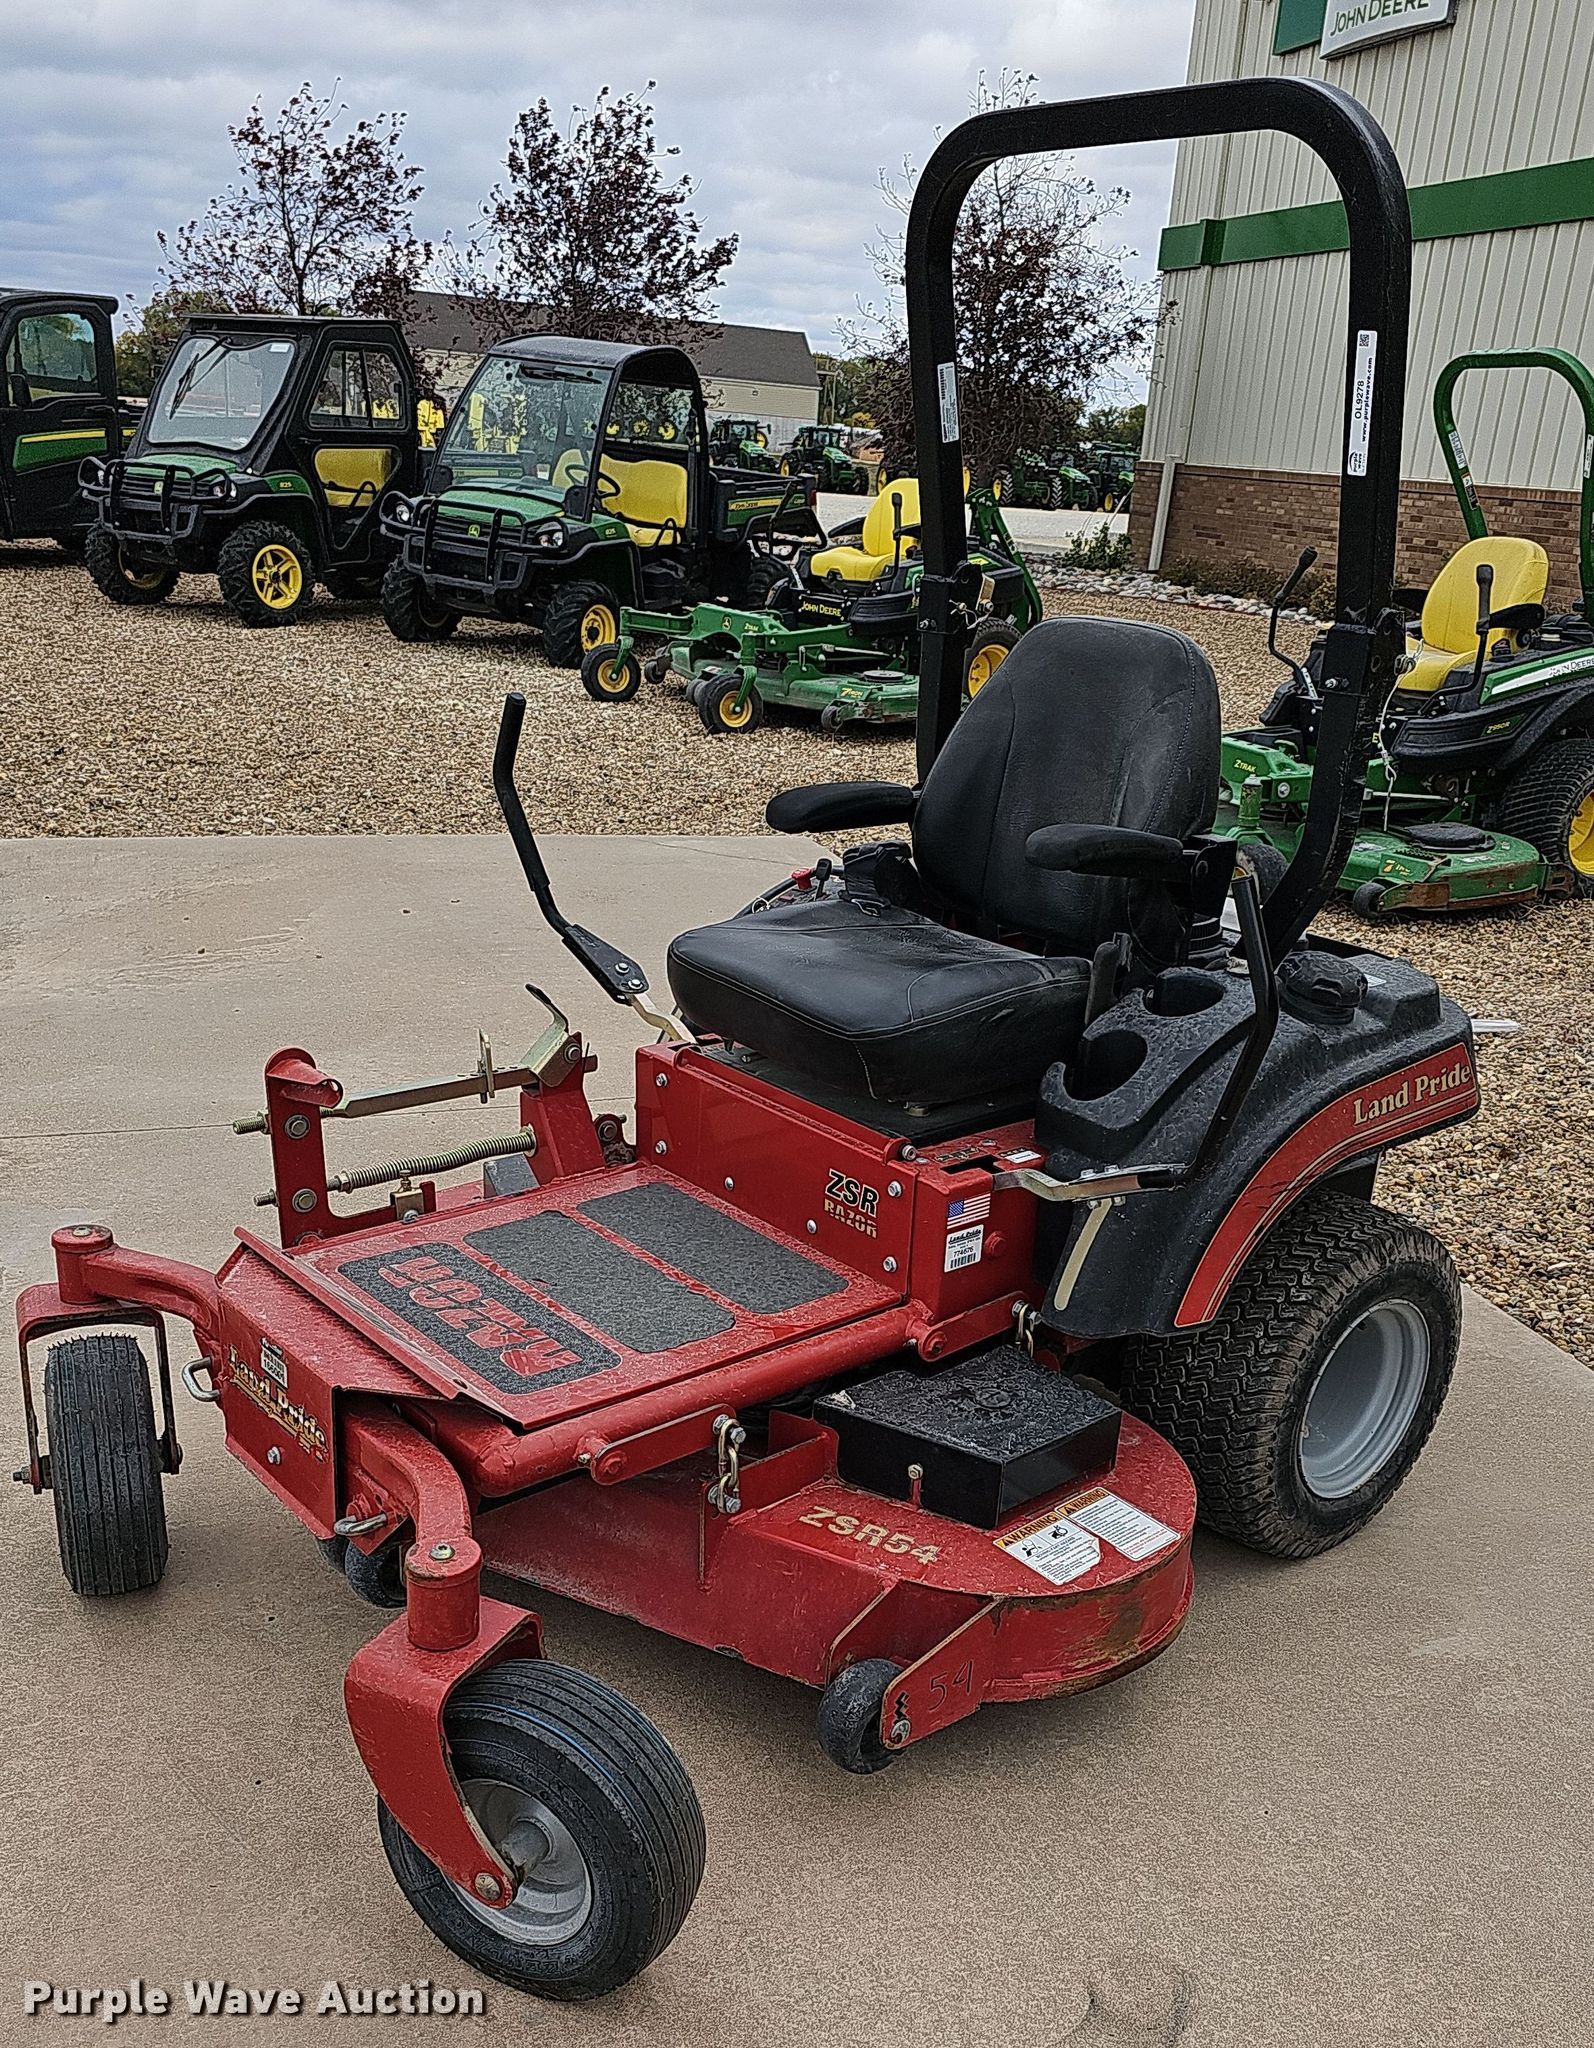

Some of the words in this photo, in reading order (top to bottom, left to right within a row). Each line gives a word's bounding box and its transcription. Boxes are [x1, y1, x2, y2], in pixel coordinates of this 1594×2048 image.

[1329, 4, 1367, 37] JOHN
[1354, 380, 1365, 420] OL9278
[1362, 357, 1373, 442] www.purplewave.com
[801, 600, 819, 613] JOHN
[819, 603, 842, 617] DEERE
[1233, 759, 1257, 773] ZTRAK
[1353, 1081, 1410, 1125] Land
[1414, 1062, 1472, 1102] Pride
[825, 1168, 880, 1218] ZSR
[824, 1198, 877, 1239] RAZOR
[378, 1256, 584, 1377] RAZOR
[228, 1345, 272, 1404] Land
[276, 1385, 330, 1453] Pride
[1073, 1489, 1106, 1510] WARNING
[799, 1506, 941, 1565] ZSR54
[1009, 1514, 1060, 1542] WARNING
[928, 1660, 975, 1712] 54
